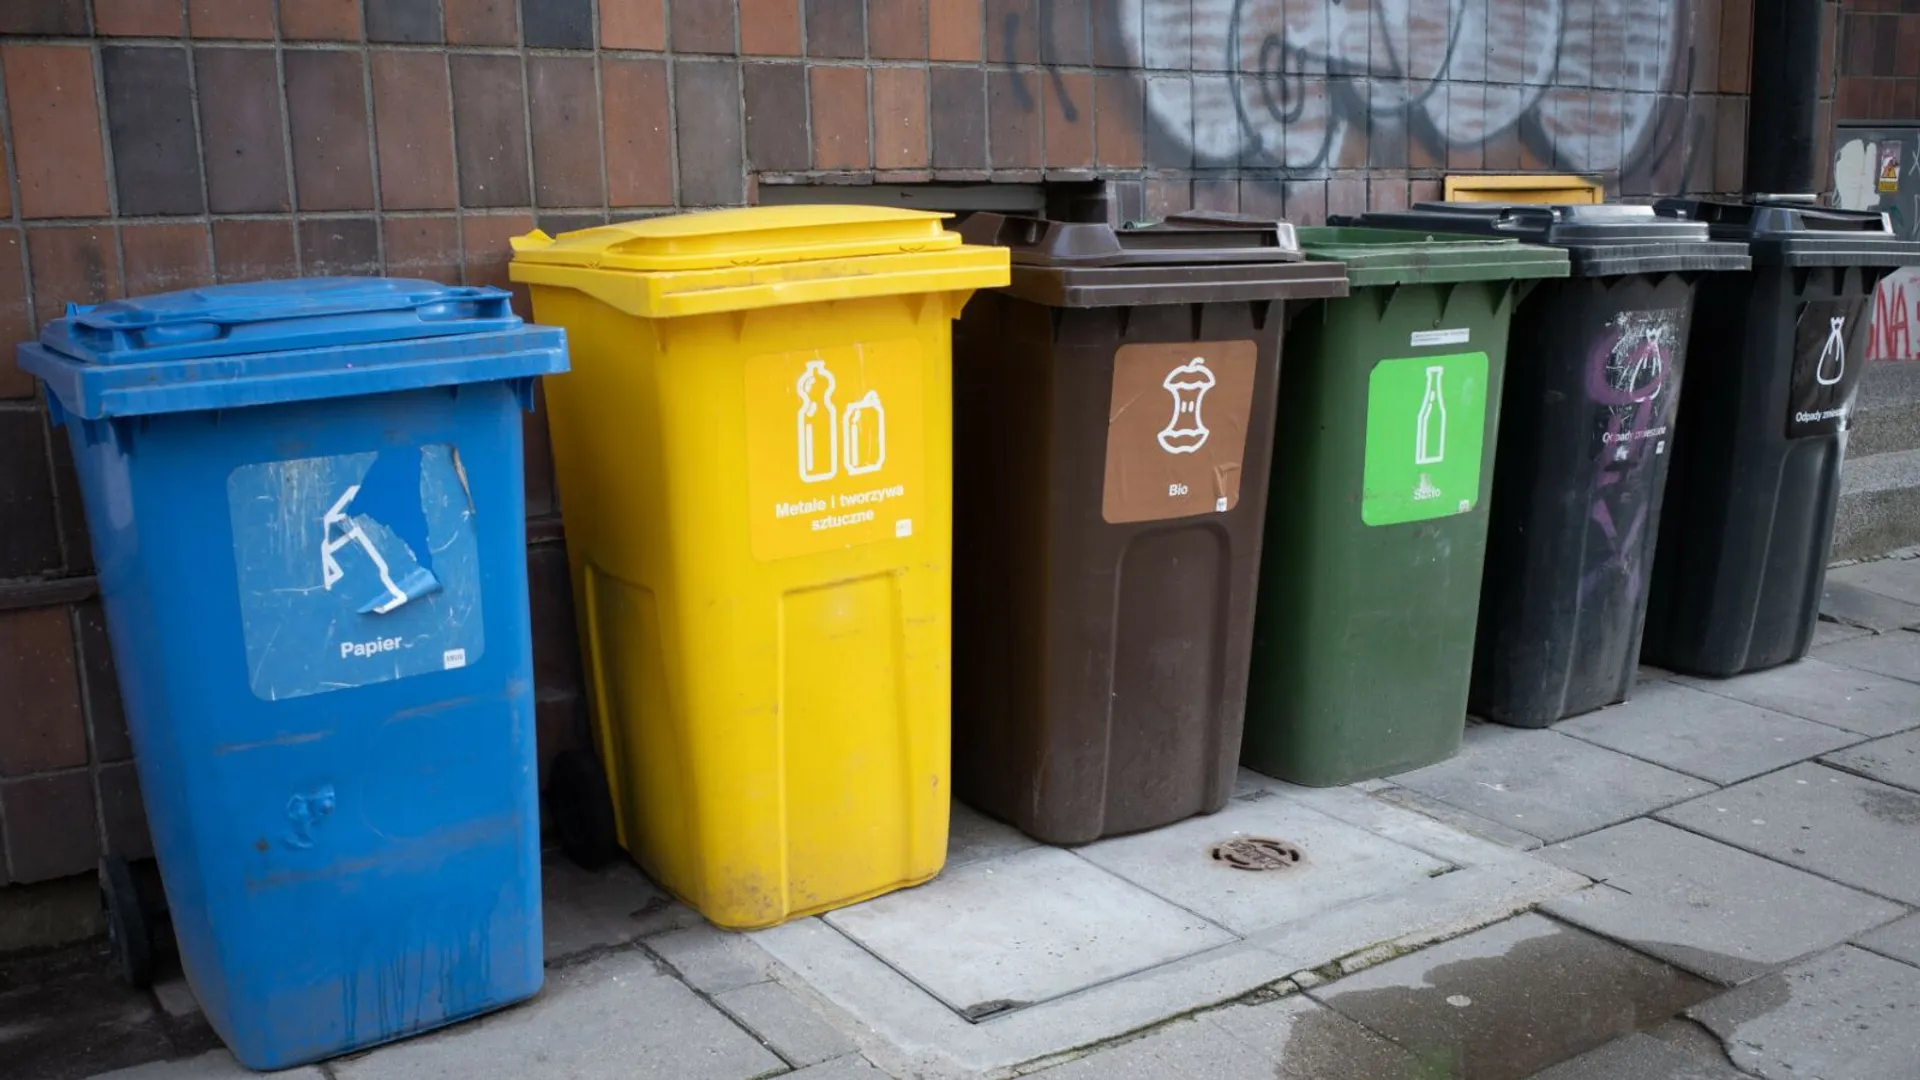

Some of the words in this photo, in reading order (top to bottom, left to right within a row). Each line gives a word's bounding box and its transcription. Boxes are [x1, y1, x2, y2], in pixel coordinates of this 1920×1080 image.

[1795, 409, 1821, 423] Odpady
[1169, 483, 1188, 497] Bio
[776, 499, 827, 519] Metale
[831, 495, 835, 508] i
[839, 484, 904, 507] tworzywa
[811, 509, 874, 531] sztuczne
[340, 637, 402, 659] Papier
